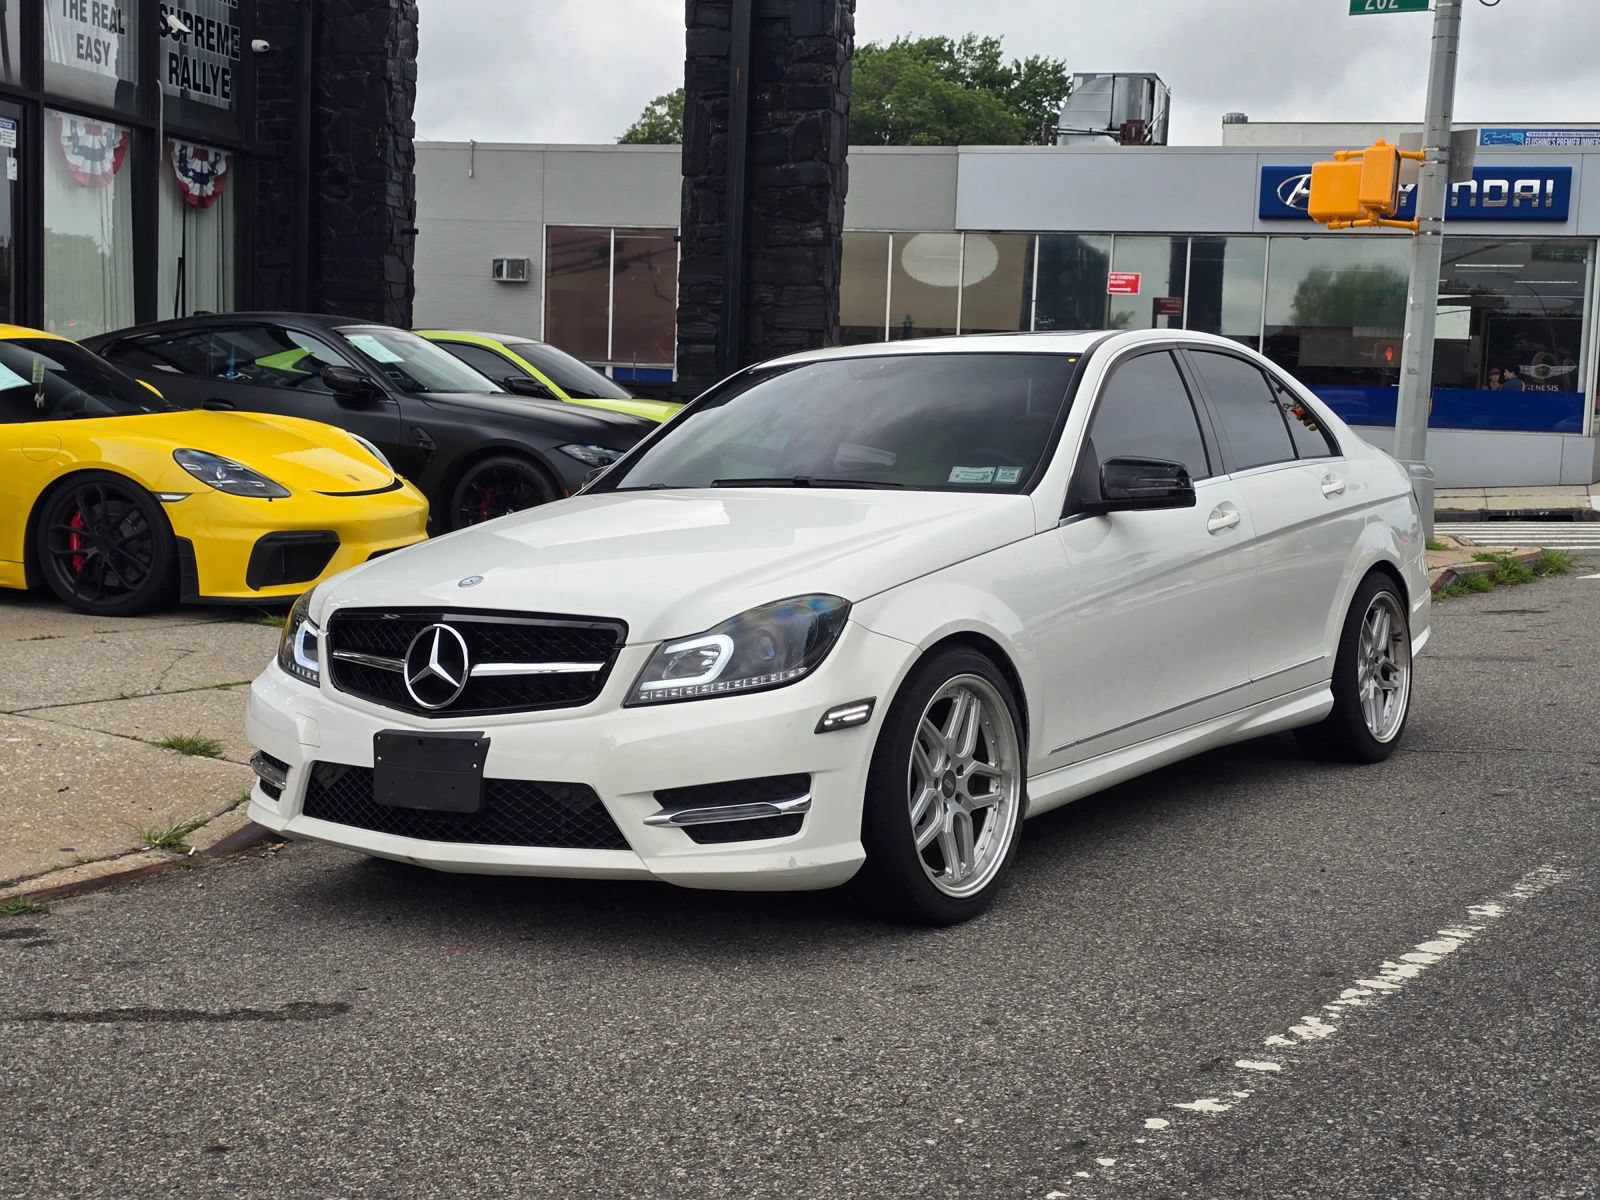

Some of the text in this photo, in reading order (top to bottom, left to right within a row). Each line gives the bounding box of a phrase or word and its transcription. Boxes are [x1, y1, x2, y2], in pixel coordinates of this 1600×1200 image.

[92, 1, 125, 35] REAL
[160, 4, 240, 61] SUPREME
[76, 33, 111, 66] EASY
[168, 52, 231, 100] RALLYE
